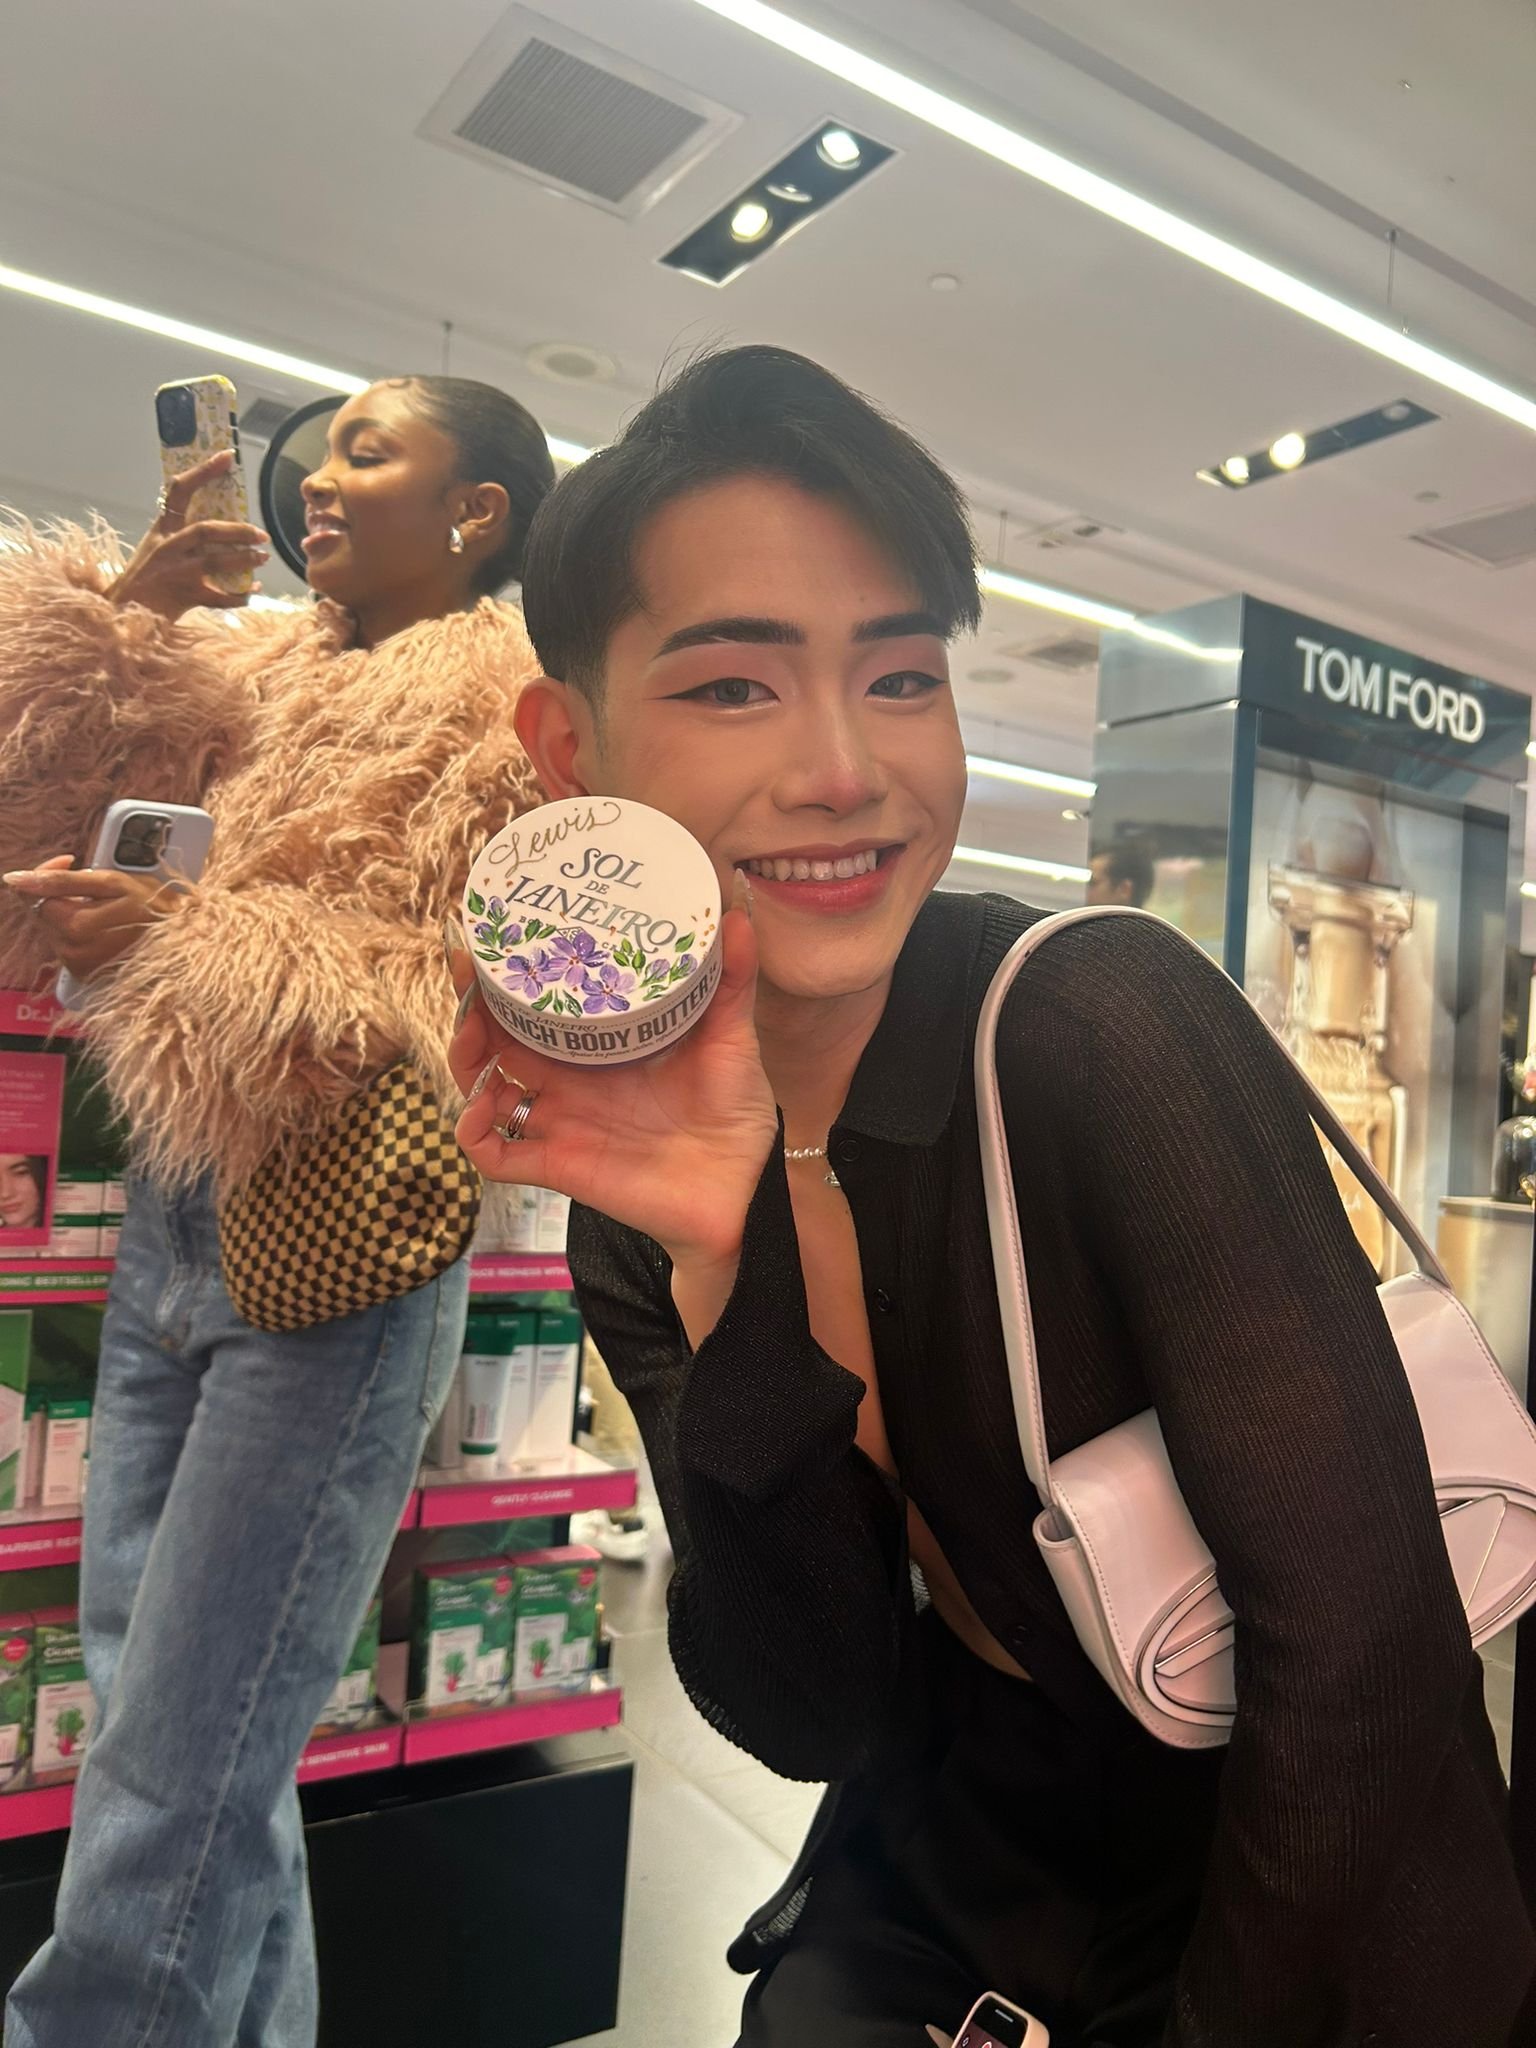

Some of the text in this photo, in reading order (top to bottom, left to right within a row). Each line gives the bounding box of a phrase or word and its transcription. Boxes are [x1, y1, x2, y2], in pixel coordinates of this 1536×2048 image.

[1295, 636, 1486, 744] TOM FORD
[489, 802, 621, 878] Lewis
[560, 848, 644, 889] SOL
[505, 875, 677, 954] JANEIRO
[584, 880, 610, 895] DE
[564, 1028, 631, 1051] BODY
[638, 974, 709, 1043] BUTTER
[34, 1274, 108, 1287] BESTSELLER
